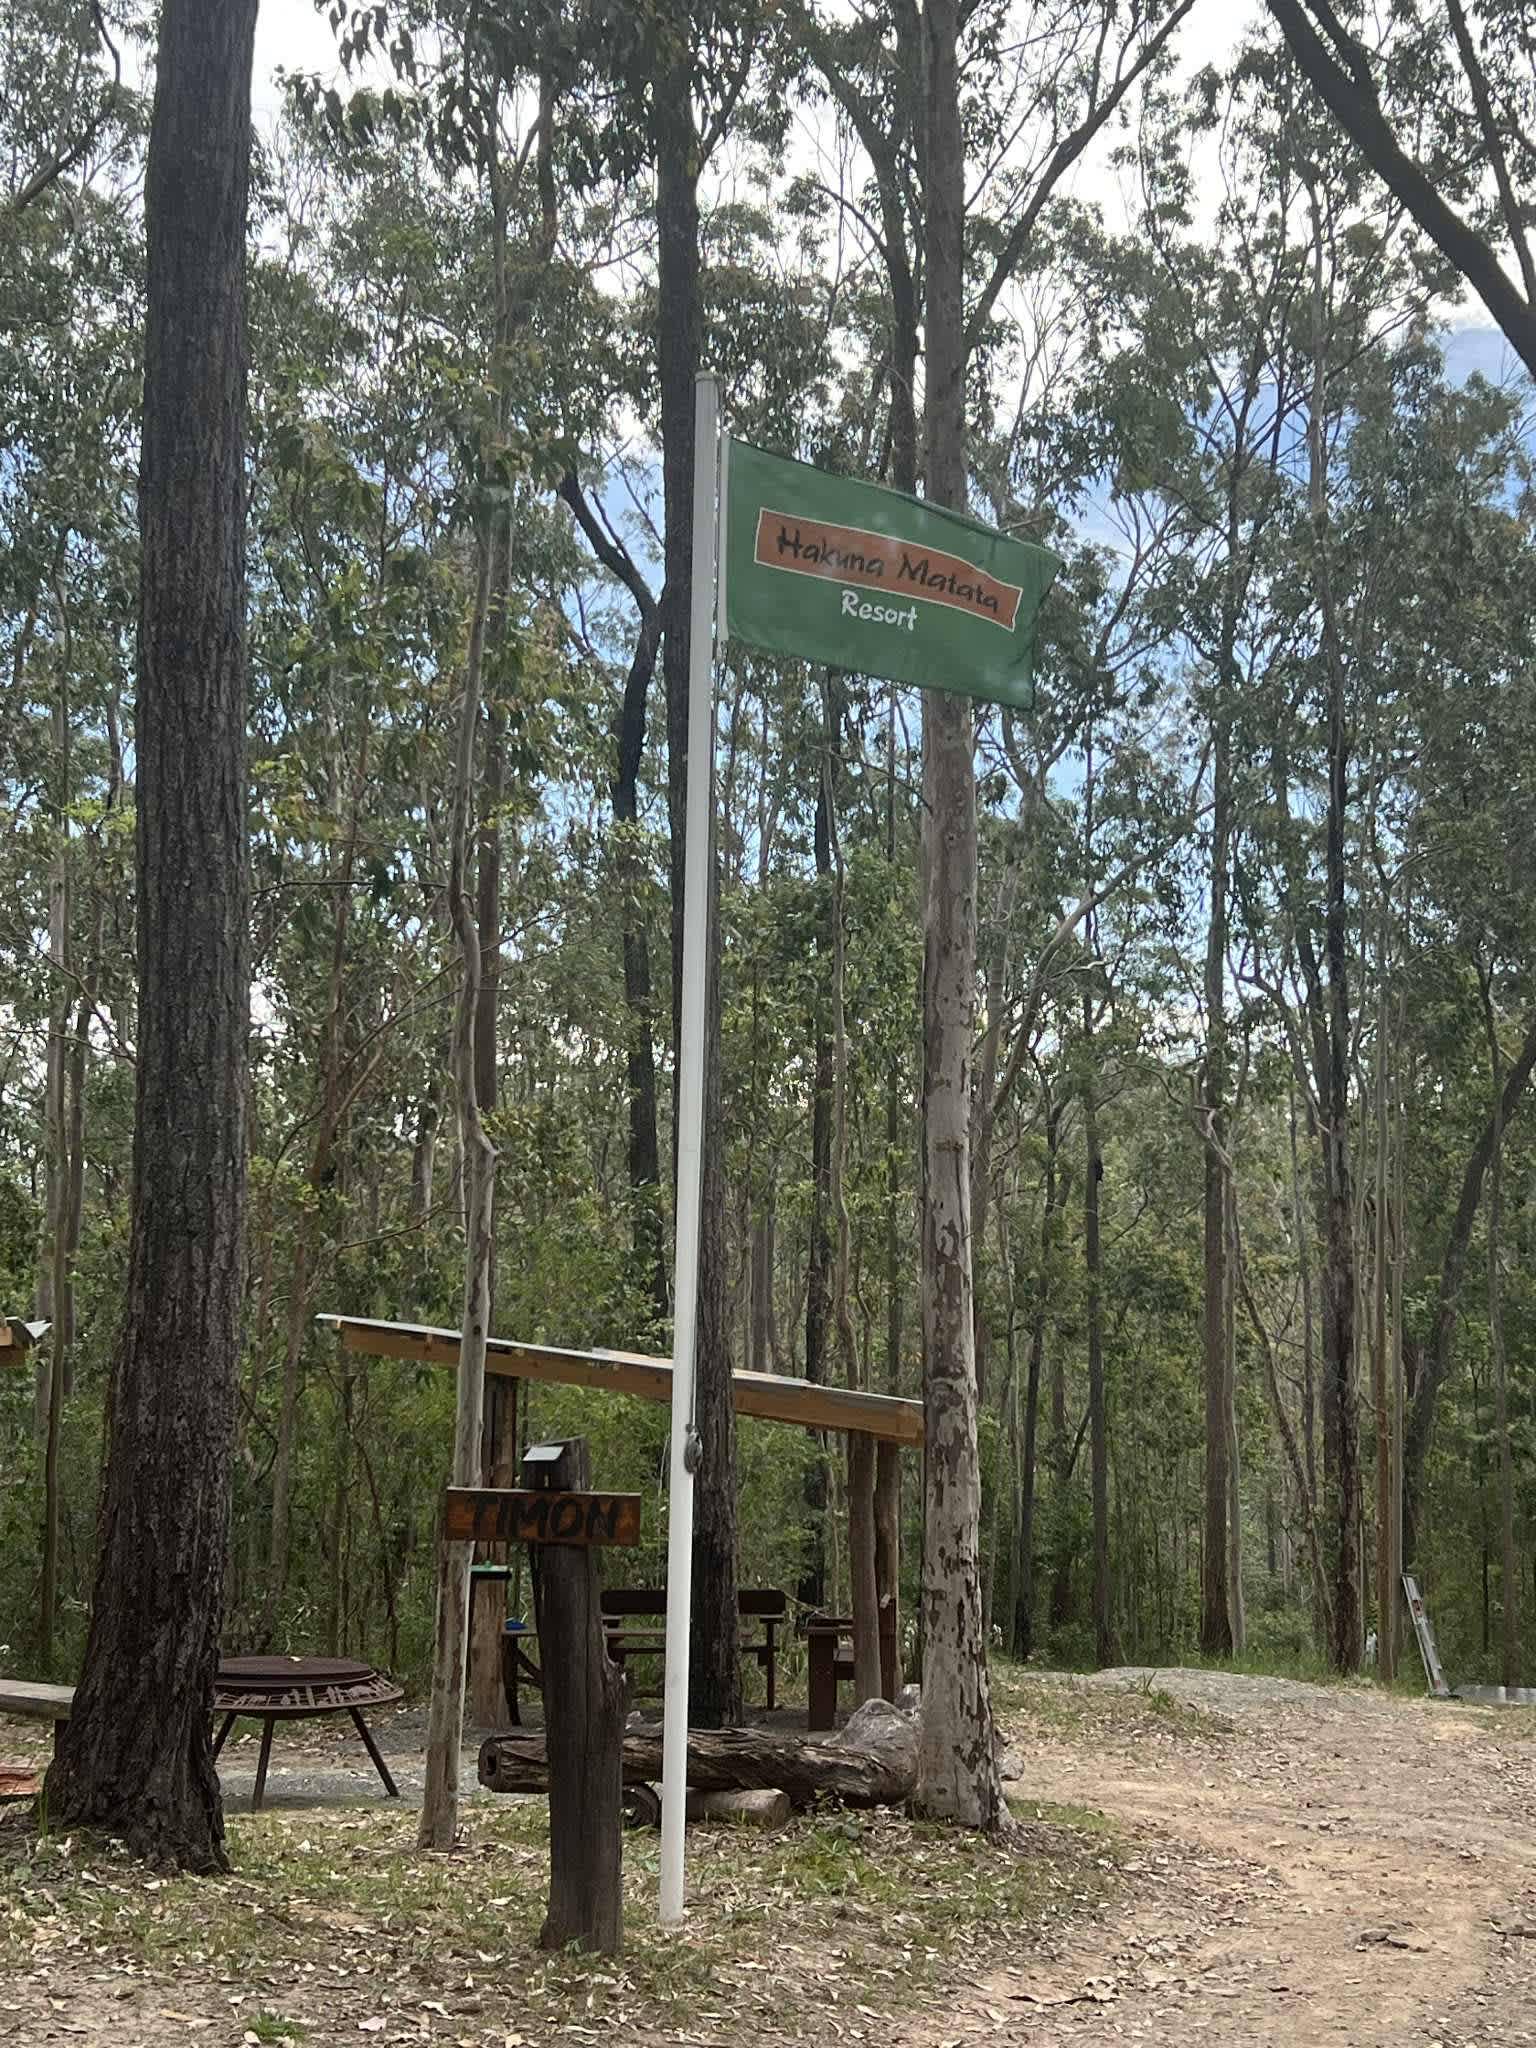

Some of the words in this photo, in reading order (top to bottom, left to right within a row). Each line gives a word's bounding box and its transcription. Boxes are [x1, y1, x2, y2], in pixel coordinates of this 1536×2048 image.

[777, 527, 884, 577] Hakuna
[898, 553, 999, 613] Matata
[840, 589, 919, 632] Resort
[465, 1494, 623, 1540] TIMON
